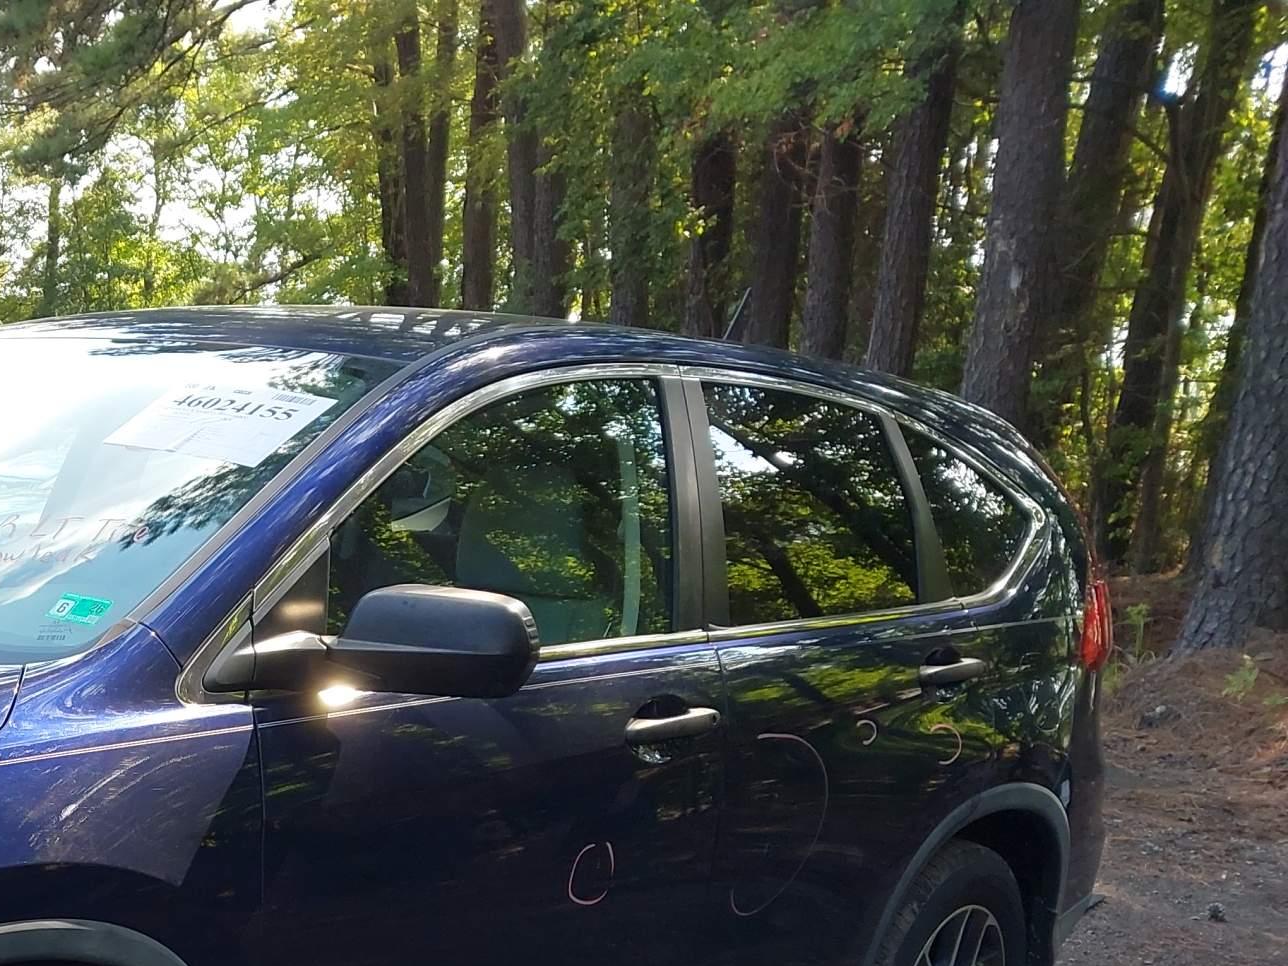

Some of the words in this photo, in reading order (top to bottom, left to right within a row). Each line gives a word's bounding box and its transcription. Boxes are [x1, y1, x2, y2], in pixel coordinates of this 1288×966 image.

[173, 394, 299, 421] 46024155
[92, 518, 150, 543] Tie
[56, 601, 70, 614] 6
